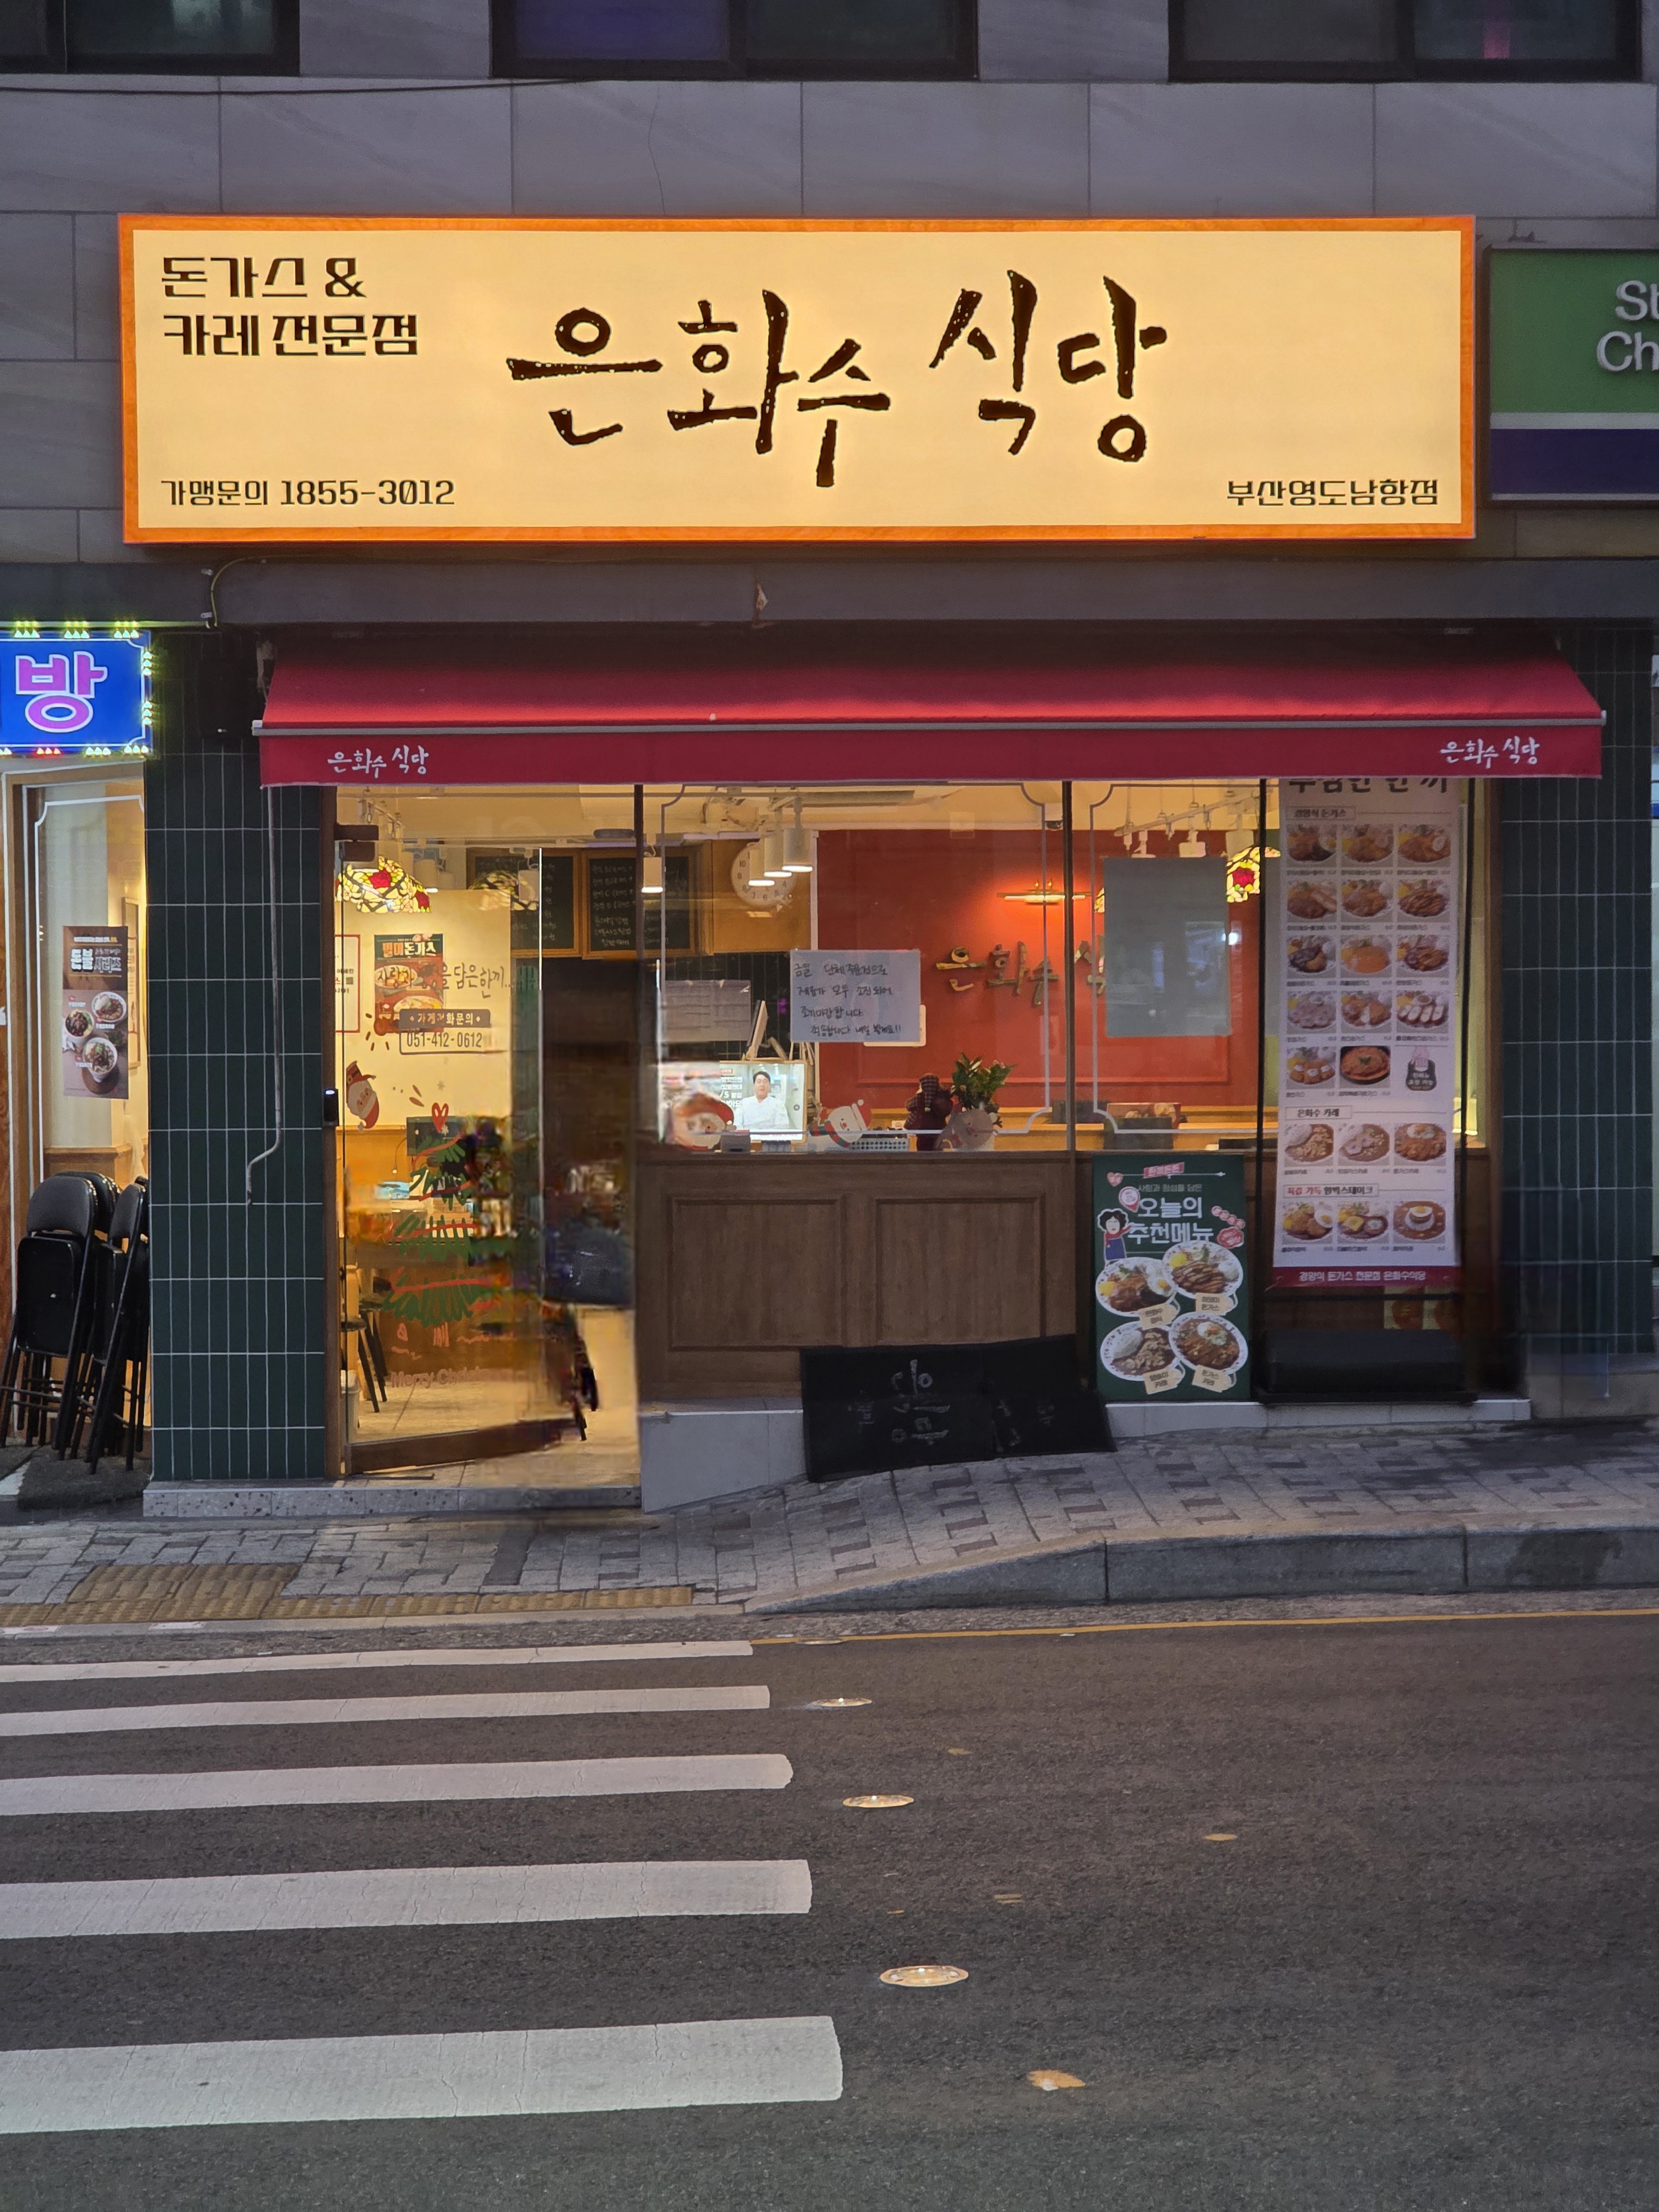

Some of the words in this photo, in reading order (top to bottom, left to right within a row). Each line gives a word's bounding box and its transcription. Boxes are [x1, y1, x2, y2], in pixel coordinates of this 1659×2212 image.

[161, 256, 307, 298] 돈가스
[325, 257, 367, 298] &
[163, 314, 260, 356] 카레
[272, 314, 418, 356] 전문점
[1597, 331, 1659, 372] Ch
[506, 289, 891, 488] 은화수
[928, 270, 1168, 462] 식당
[161, 480, 269, 506] 가맹문의
[280, 479, 455, 505] 1855-3012
[1227, 478, 1438, 506] 부산영도남항점
[15, 651, 108, 733] 방
[327, 748, 387, 779] 은화수
[392, 744, 429, 774] 식당
[1439, 738, 1499, 769] 은화수
[1502, 735, 1540, 764] 식당
[94, 956, 122, 973] 시리즈
[454, 962, 479, 989] 담은
[794, 963, 813, 978] 금일
[936, 940, 1060, 1005] 은화수
[797, 985, 826, 997] 재료가
[832, 984, 850, 998] 모두
[1298, 1108, 1321, 1118] 은화수
[1323, 1108, 1339, 1117] 카레
[1138, 1197, 1203, 1218] 오늘의
[1128, 1222, 1214, 1244] 추천메뉴
[1300, 1271, 1325, 1282] 경양식
[1328, 1271, 1353, 1281] 돈가스
[1356, 1271, 1381, 1281] 전문점
[390, 1371, 434, 1389] Merry
